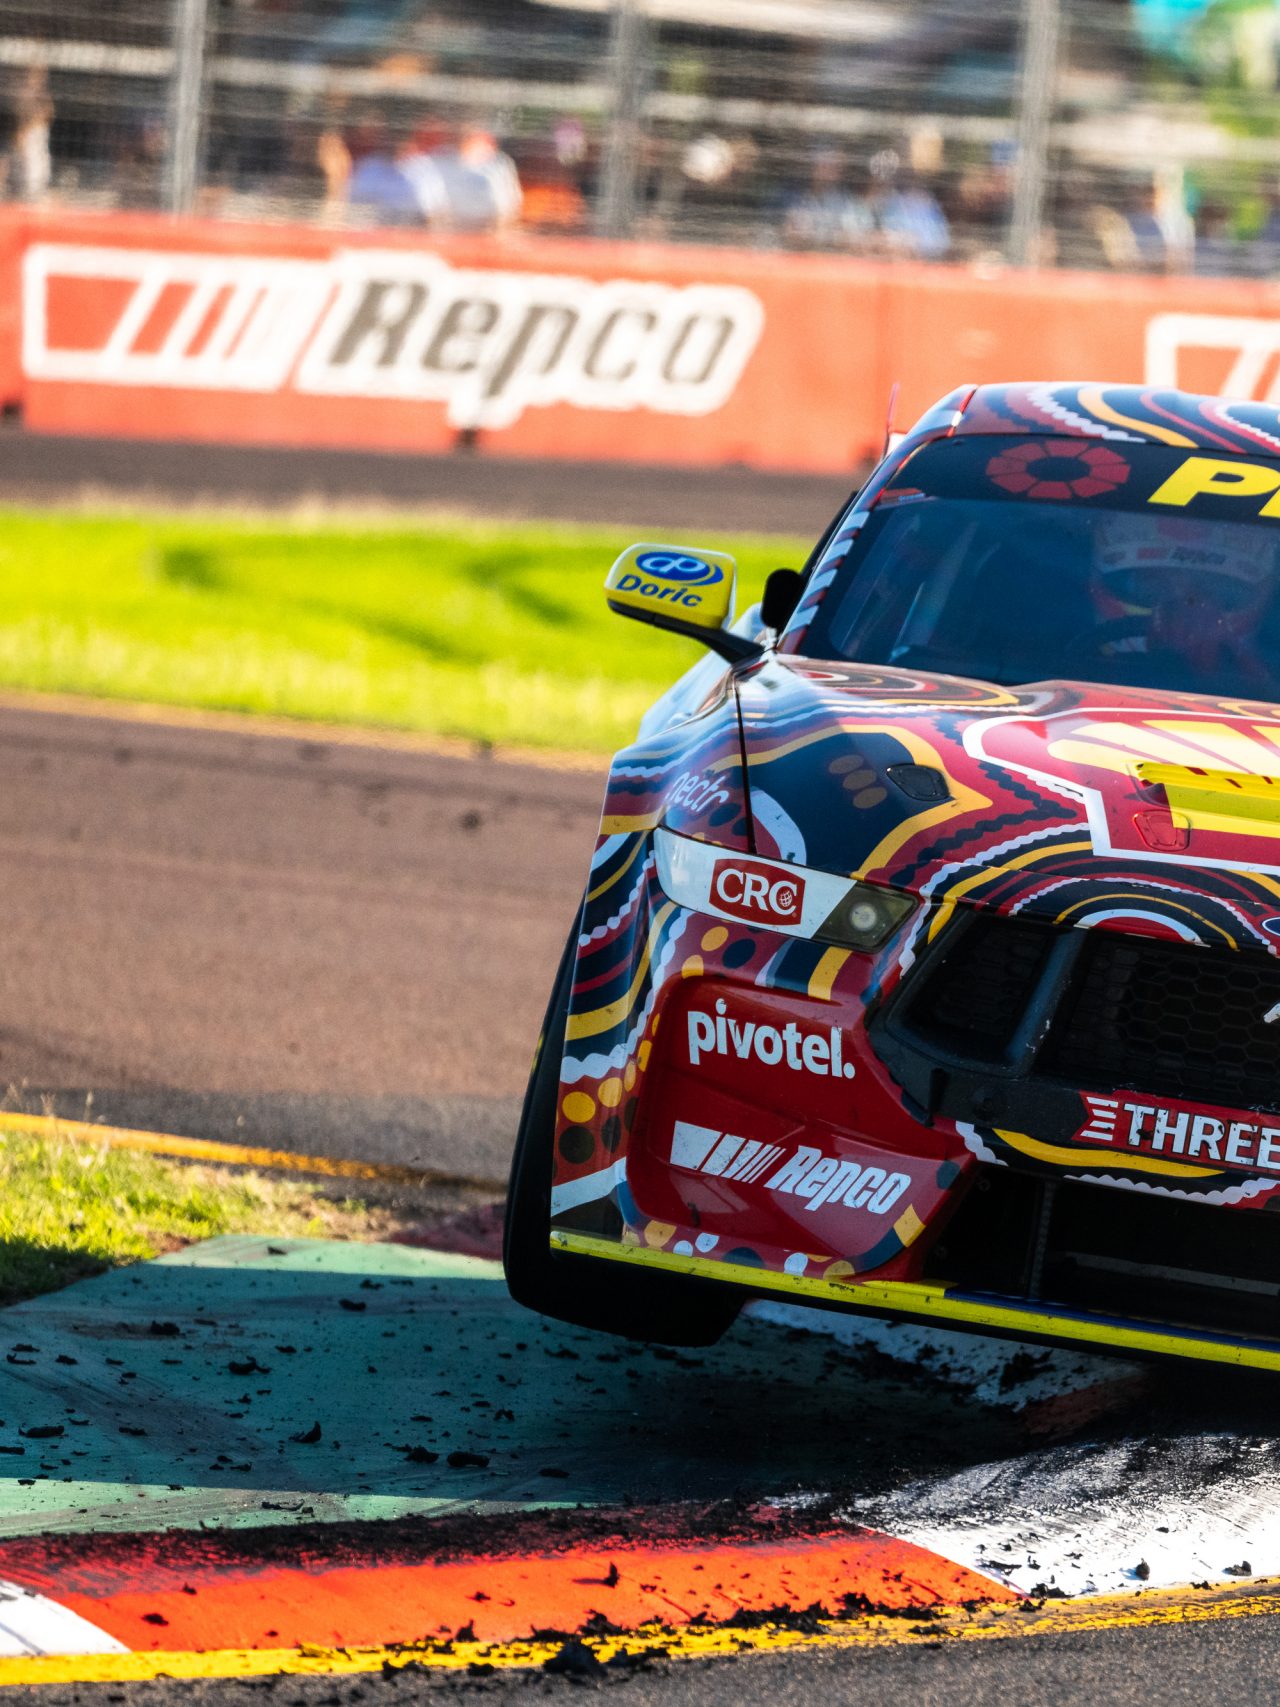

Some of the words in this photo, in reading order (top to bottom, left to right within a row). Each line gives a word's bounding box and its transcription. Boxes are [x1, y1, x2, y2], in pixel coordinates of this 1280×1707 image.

[326, 276, 737, 400] Repco
[615, 573, 703, 608] Doric
[715, 867, 798, 916] CRC
[686, 997, 856, 1080] pivotel.
[763, 1144, 912, 1215] Repco
